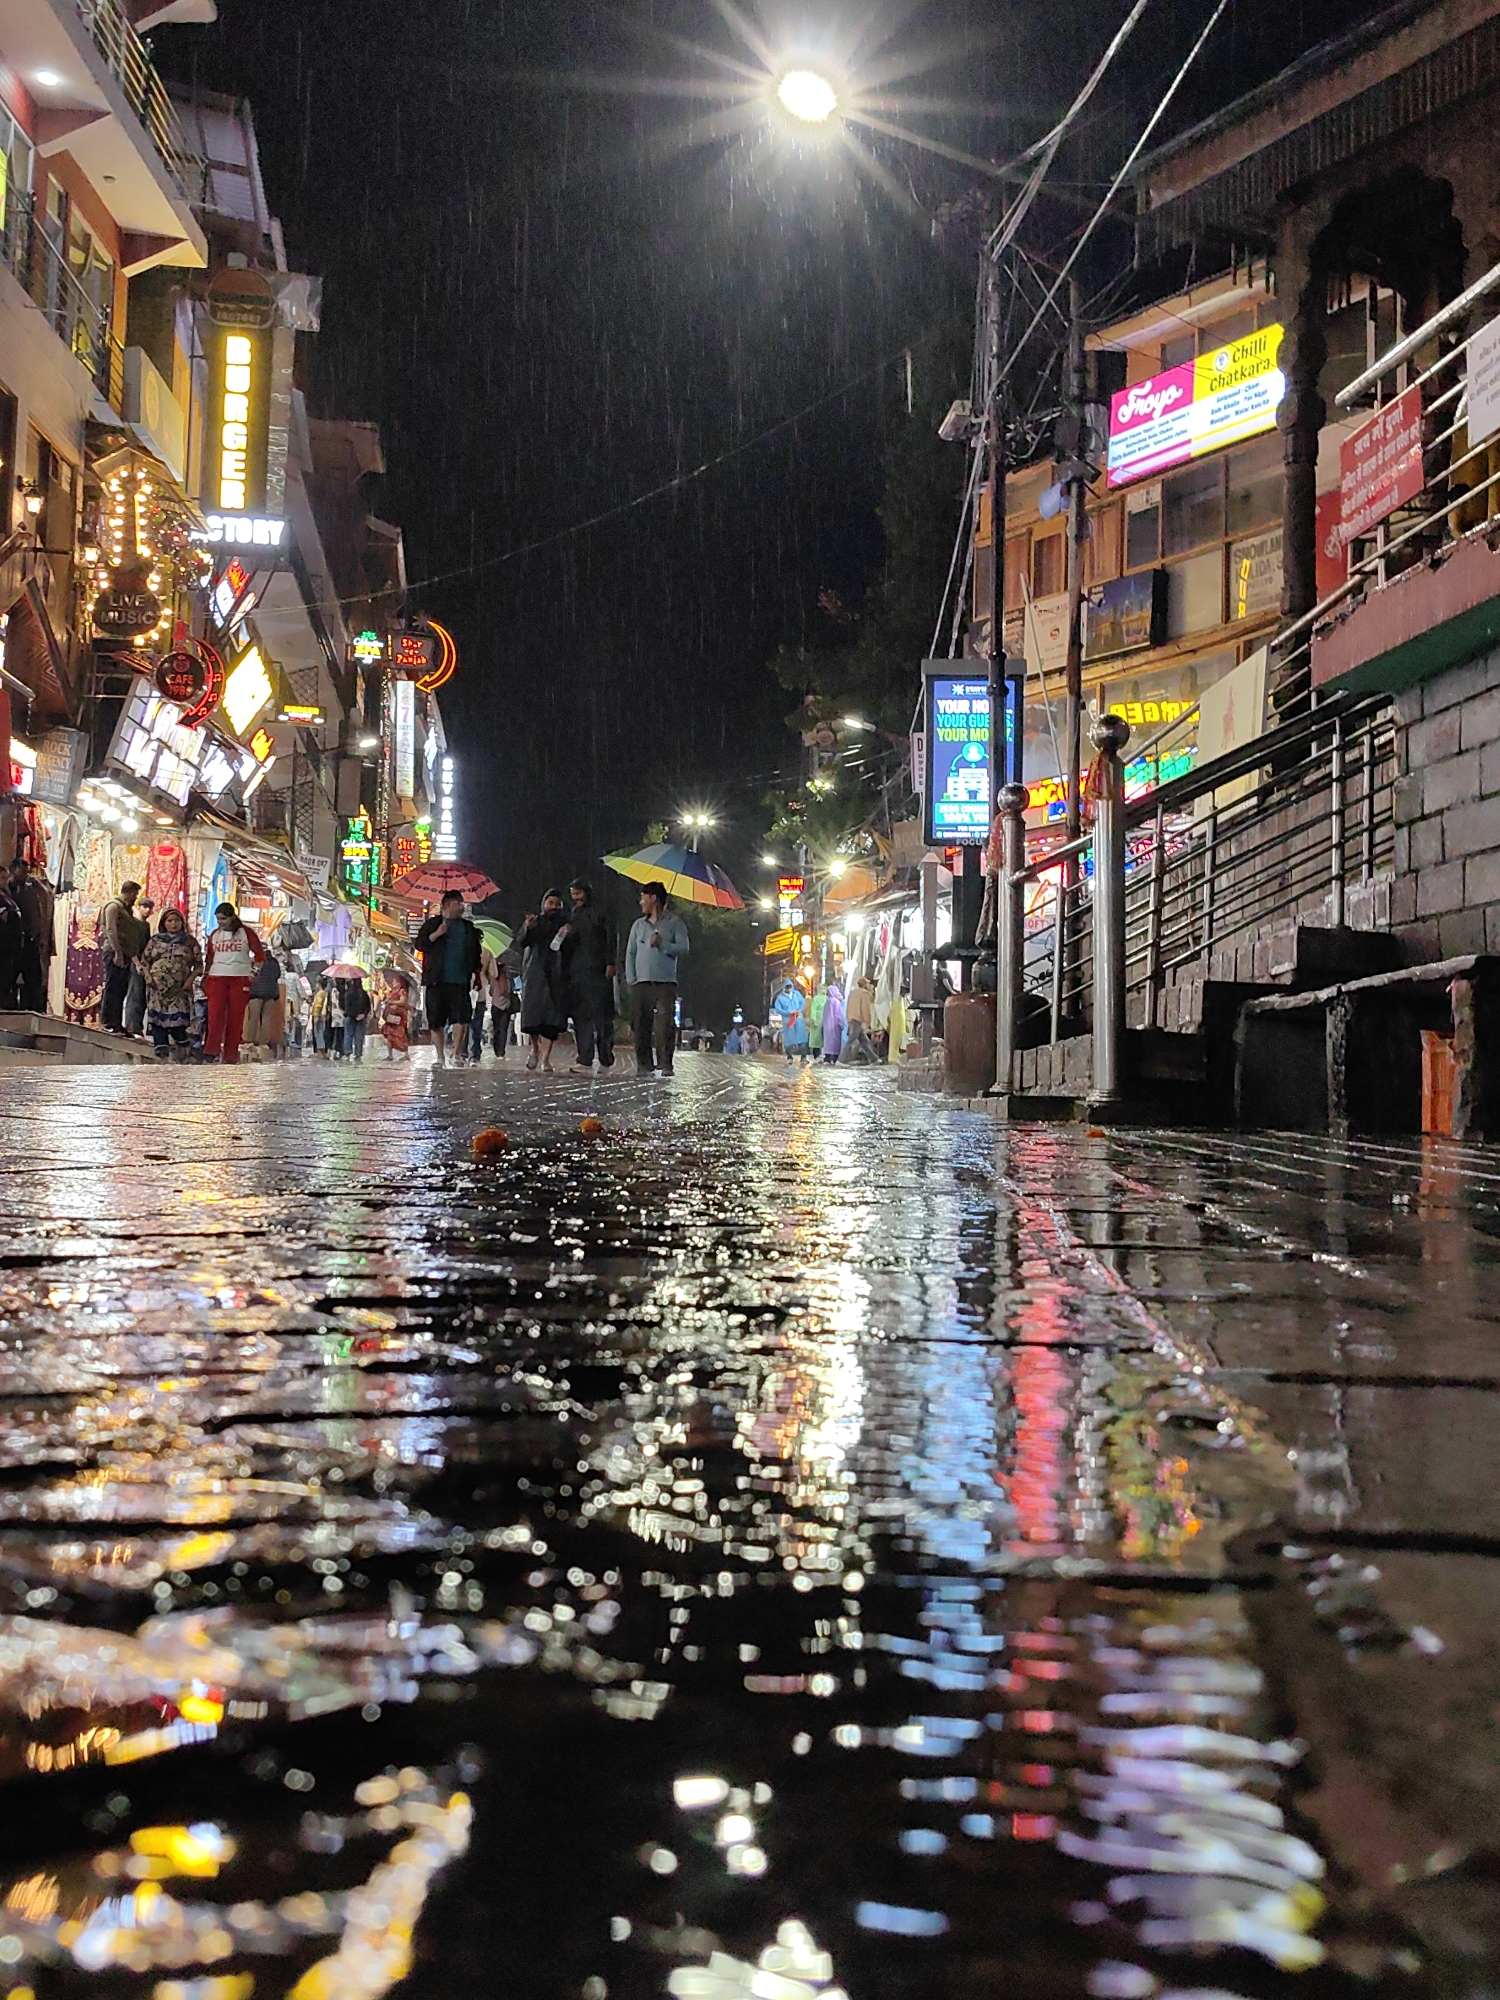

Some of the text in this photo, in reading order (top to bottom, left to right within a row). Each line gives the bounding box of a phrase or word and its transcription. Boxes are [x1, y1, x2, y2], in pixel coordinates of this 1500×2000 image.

[1232, 335, 1268, 363] Chilli
[1209, 358, 1271, 392] Chatkara
[1118, 381, 1183, 424] Froyo
[221, 336, 252, 509] BURGER
[191, 514, 285, 545] CTORY
[109, 594, 145, 607] LIVE
[102, 611, 154, 625] MUSIC
[169, 674, 194, 685] CAFE
[937, 700, 970, 714] YOUR
[401, 706, 411, 724] 7
[937, 714, 967, 728] YOUR
[937, 728, 969, 742] YOUR
[43, 740, 72, 756] ROCK
[37, 752, 72, 769] REGENCY
[956, 838, 985, 846] FOCU
[344, 846, 369, 857] SPA
[213, 943, 242, 953] NIKE
